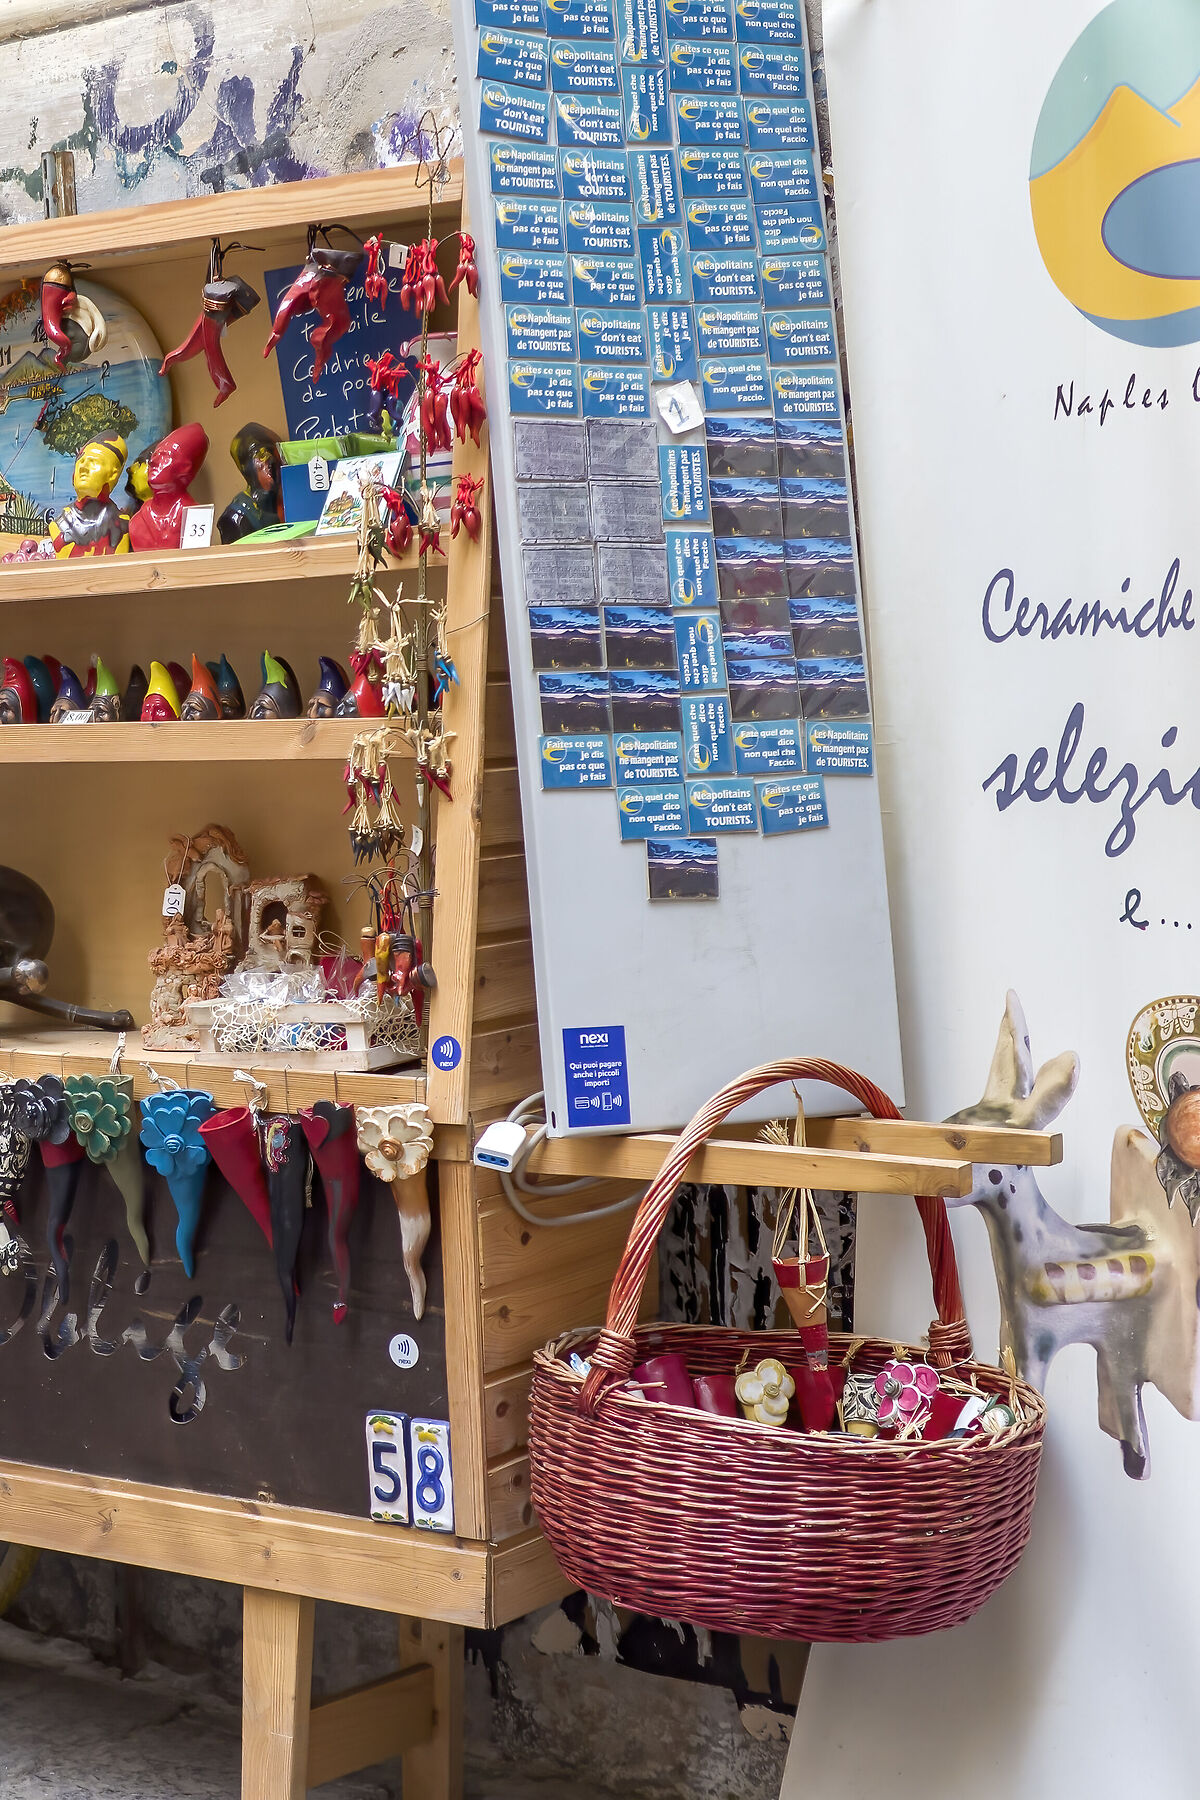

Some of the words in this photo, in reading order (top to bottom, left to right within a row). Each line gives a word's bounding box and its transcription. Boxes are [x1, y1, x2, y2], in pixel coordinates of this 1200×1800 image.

[747, 51, 764, 59] Fate
[766, 53, 783, 62] quel
[574, 64, 598, 73] don't
[568, 76, 616, 86] TOURISTS.
[767, 73, 784, 81] quel
[773, 83, 800, 91] Faccio.
[504, 108, 528, 119] don't
[530, 115, 545, 124] eat
[495, 119, 544, 137] TOURISTS.
[497, 149, 510, 158] Les
[512, 150, 554, 162] Napolitains
[496, 163, 506, 172] ne
[507, 165, 540, 176] mangent
[542, 168, 555, 177] pas
[500, 177, 510, 186] de
[511, 177, 556, 189] TOURISTES.
[778, 216, 795, 226] quel
[782, 236, 798, 245] quel
[513, 313, 526, 322] Les
[528, 313, 571, 325] Napolitains
[703, 312, 716, 321] Les
[717, 311, 758, 322] Napolitains
[523, 328, 557, 339] mangent
[559, 331, 571, 339] pas
[702, 327, 712, 335] ne
[714, 326, 745, 336] mangent
[747, 326, 759, 336] pas
[601, 333, 625, 342] don't
[627, 334, 641, 342] eat
[708, 340, 717, 348] de
[718, 338, 761, 348] TOURISTES.
[791, 334, 814, 343] don't
[517, 341, 527, 349] de
[528, 341, 572, 352] TOURISTES.
[595, 346, 642, 356] TOURISTS.
[785, 346, 831, 356] TOURISTS.
[303, 384, 327, 402] de
[1054, 374, 1169, 426] Naples
[668, 449, 679, 496] Napolitains
[692, 450, 703, 499] TOURISTES.
[681, 465, 692, 503] mangent
[671, 498, 679, 513] Les
[685, 504, 692, 515] ne
[695, 500, 703, 511] de
[190, 524, 206, 536] 35
[982, 558, 1196, 643] Ceramiche
[760, 730, 777, 738] quel
[546, 740, 573, 749] Faites
[621, 742, 633, 750] Les
[634, 740, 678, 753] Napolitains
[580, 751, 589, 760] je
[762, 750, 779, 758] quel
[619, 756, 629, 765] ne
[630, 755, 664, 766] mangent
[665, 755, 679, 767] pas
[769, 759, 796, 767] Faccio.
[560, 764, 575, 772] pas
[588, 763, 605, 771] que
[580, 773, 589, 783] je
[624, 770, 634, 779] de
[635, 768, 679, 778] TOURISTES.
[645, 794, 663, 803] quel
[663, 803, 680, 811] dico
[712, 804, 736, 813] don't
[738, 803, 752, 811] eat
[647, 815, 665, 823] quel
[705, 815, 754, 827] TOURISTS.
[166, 892, 181, 914] 150
[579, 1033, 609, 1045] nexi
[569, 1062, 582, 1071] Qui
[583, 1062, 598, 1070] puoi
[599, 1060, 622, 1070] pagare
[598, 1069, 620, 1078] piccoli
[584, 1079, 610, 1088] importi
